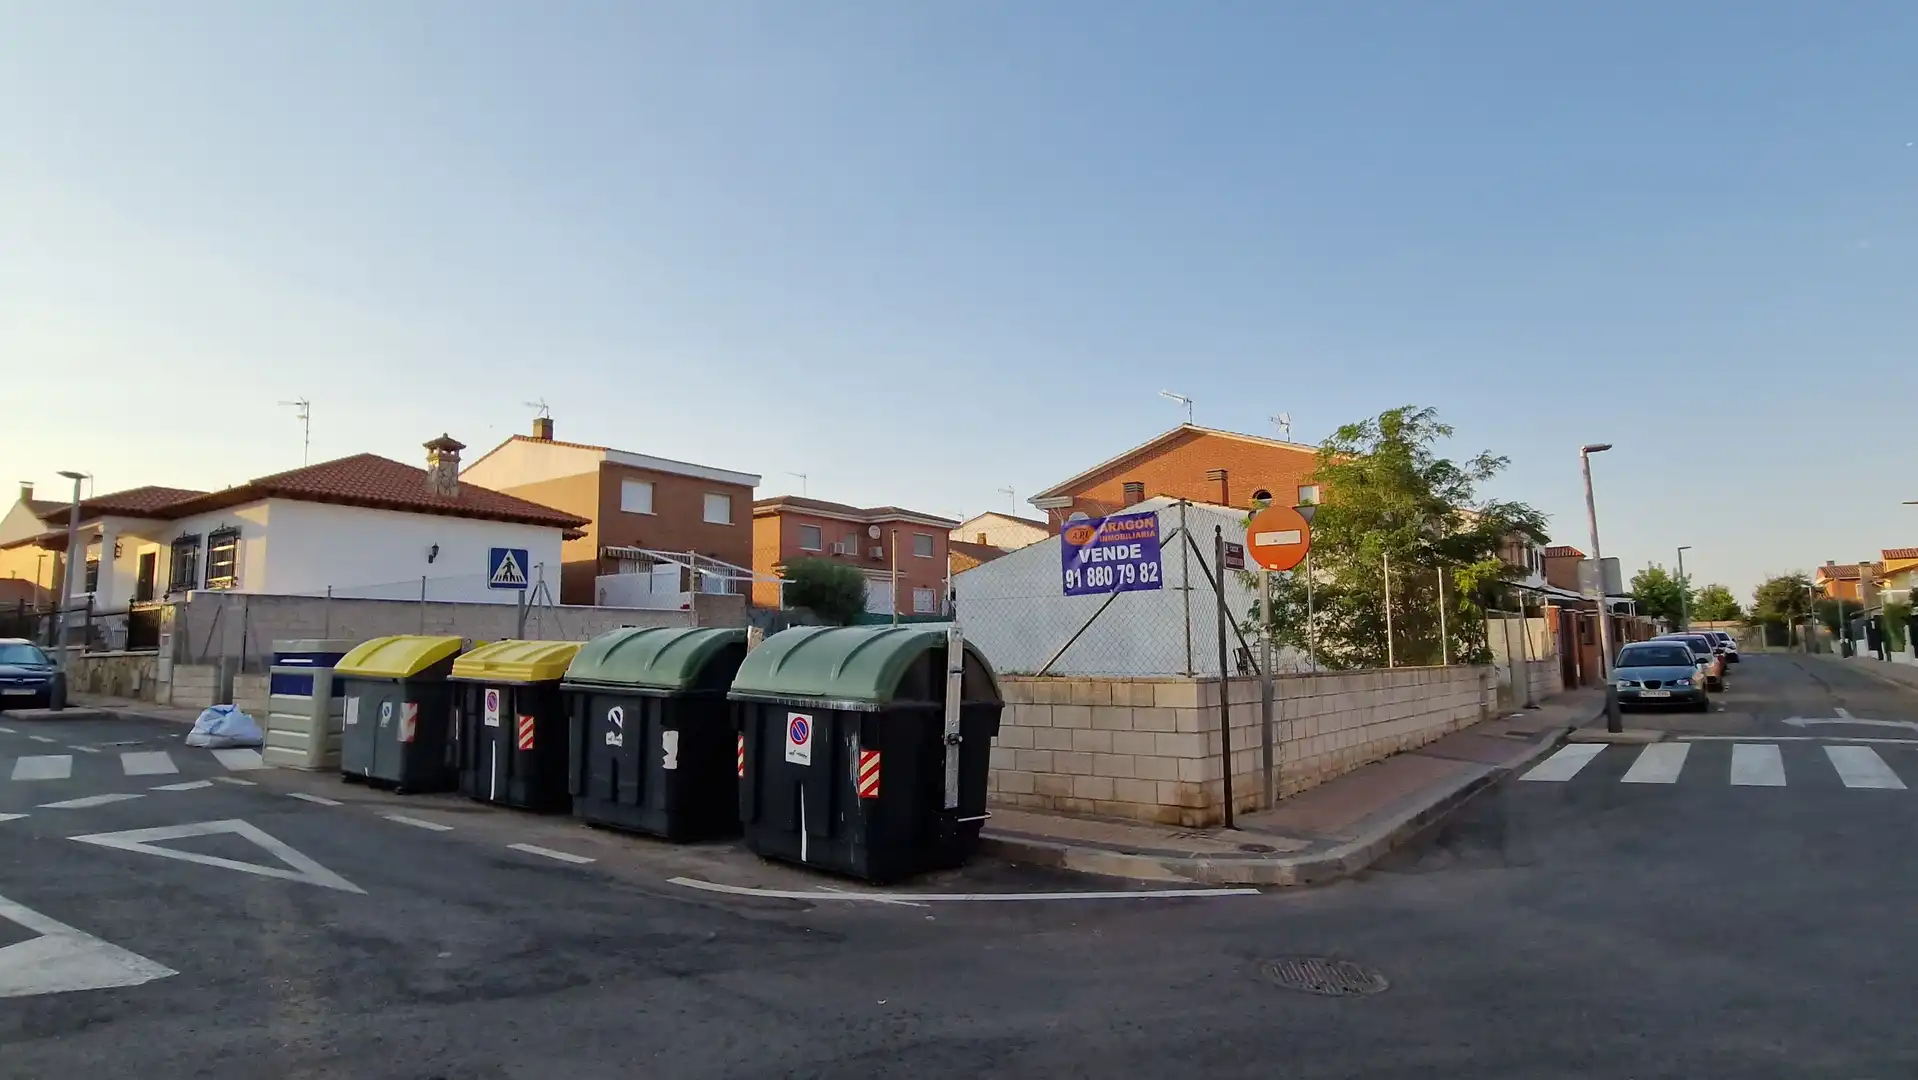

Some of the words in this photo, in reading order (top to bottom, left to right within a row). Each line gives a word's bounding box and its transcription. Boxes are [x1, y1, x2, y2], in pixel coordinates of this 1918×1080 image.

[1100, 531, 1155, 542] INMOBILIARIA
[1079, 544, 1141, 563] VENDE
[1066, 568, 1081, 589] 91
[1087, 566, 1112, 587] 880
[1117, 563, 1135, 584] 79
[1140, 562, 1158, 583] 82
